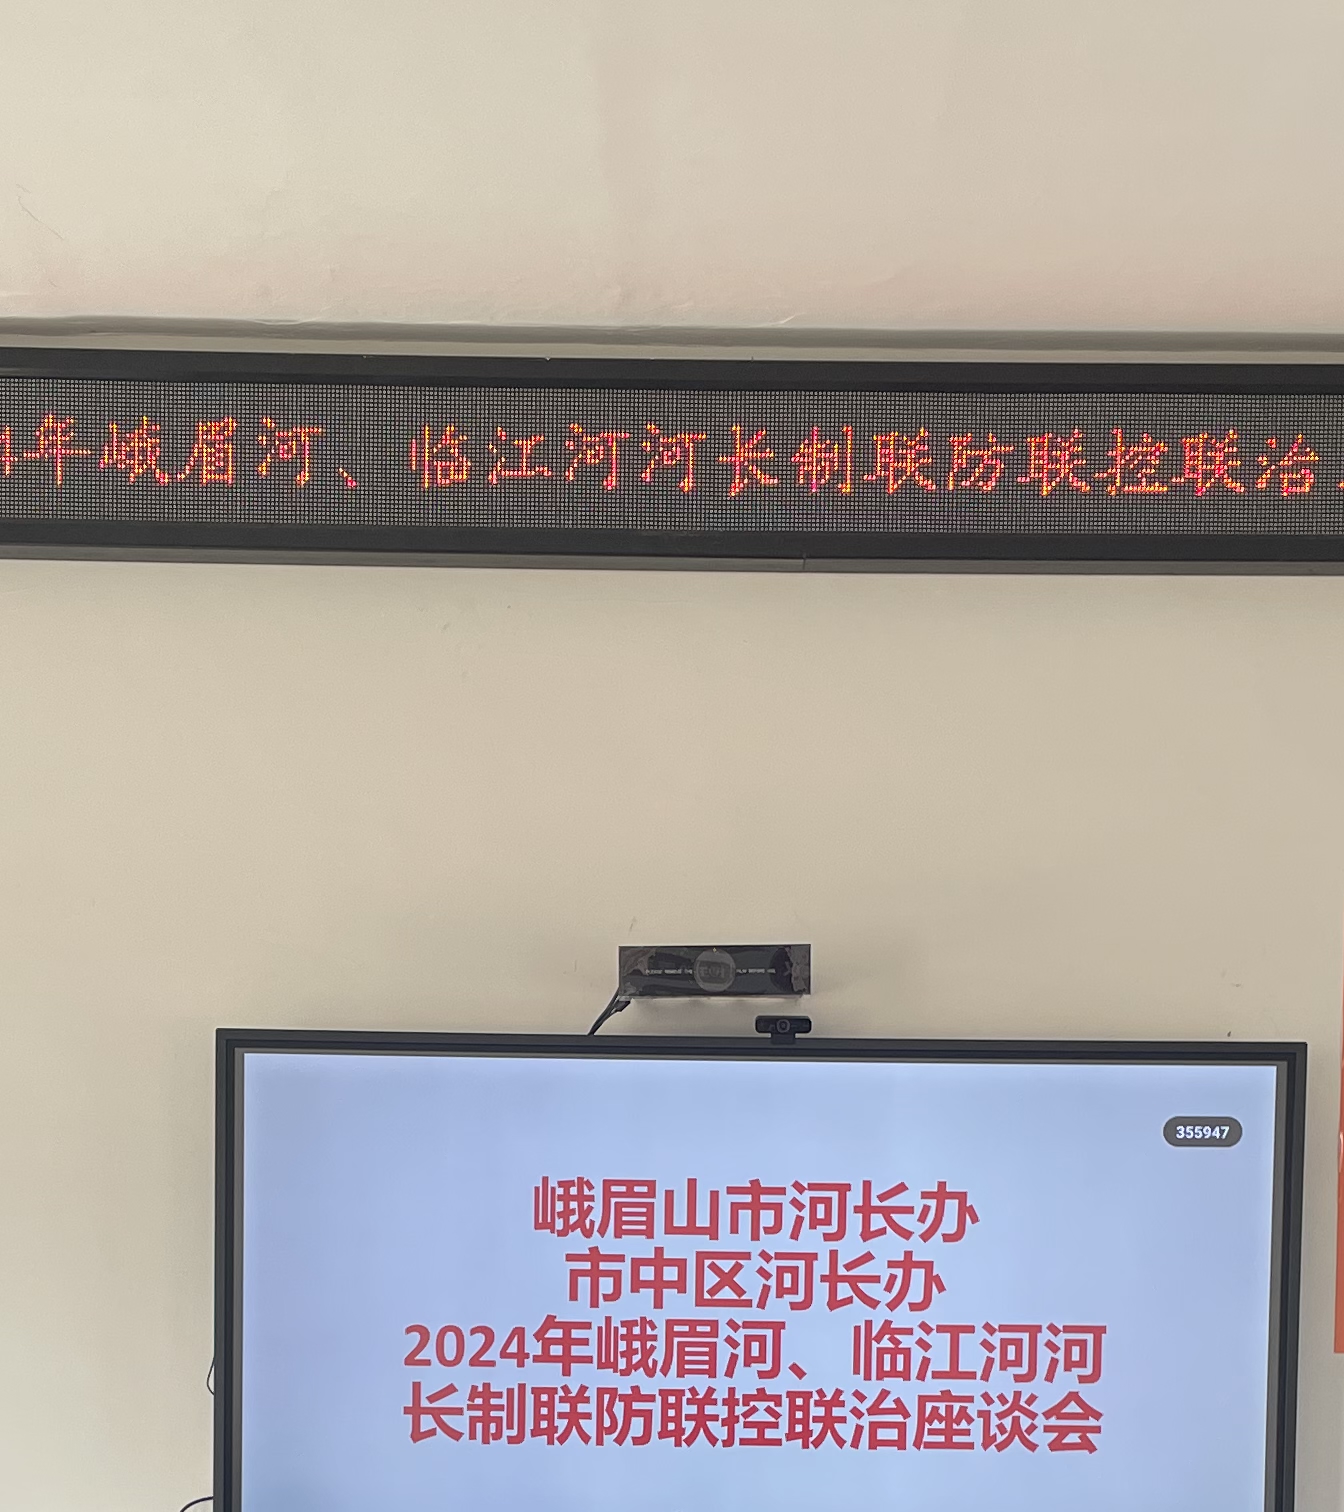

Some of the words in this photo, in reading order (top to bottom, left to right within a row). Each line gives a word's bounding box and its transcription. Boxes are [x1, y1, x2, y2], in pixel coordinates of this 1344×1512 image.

[1176, 1125, 1230, 1139] 355947
[533, 1176, 980, 1243] 峨眉山市河长办
[565, 1246, 947, 1312] 市中区河长办
[404, 1314, 1107, 1384] 2024年峨眉河、临江河河
[404, 1381, 1103, 1454] 长制联防联控联治座谈会
